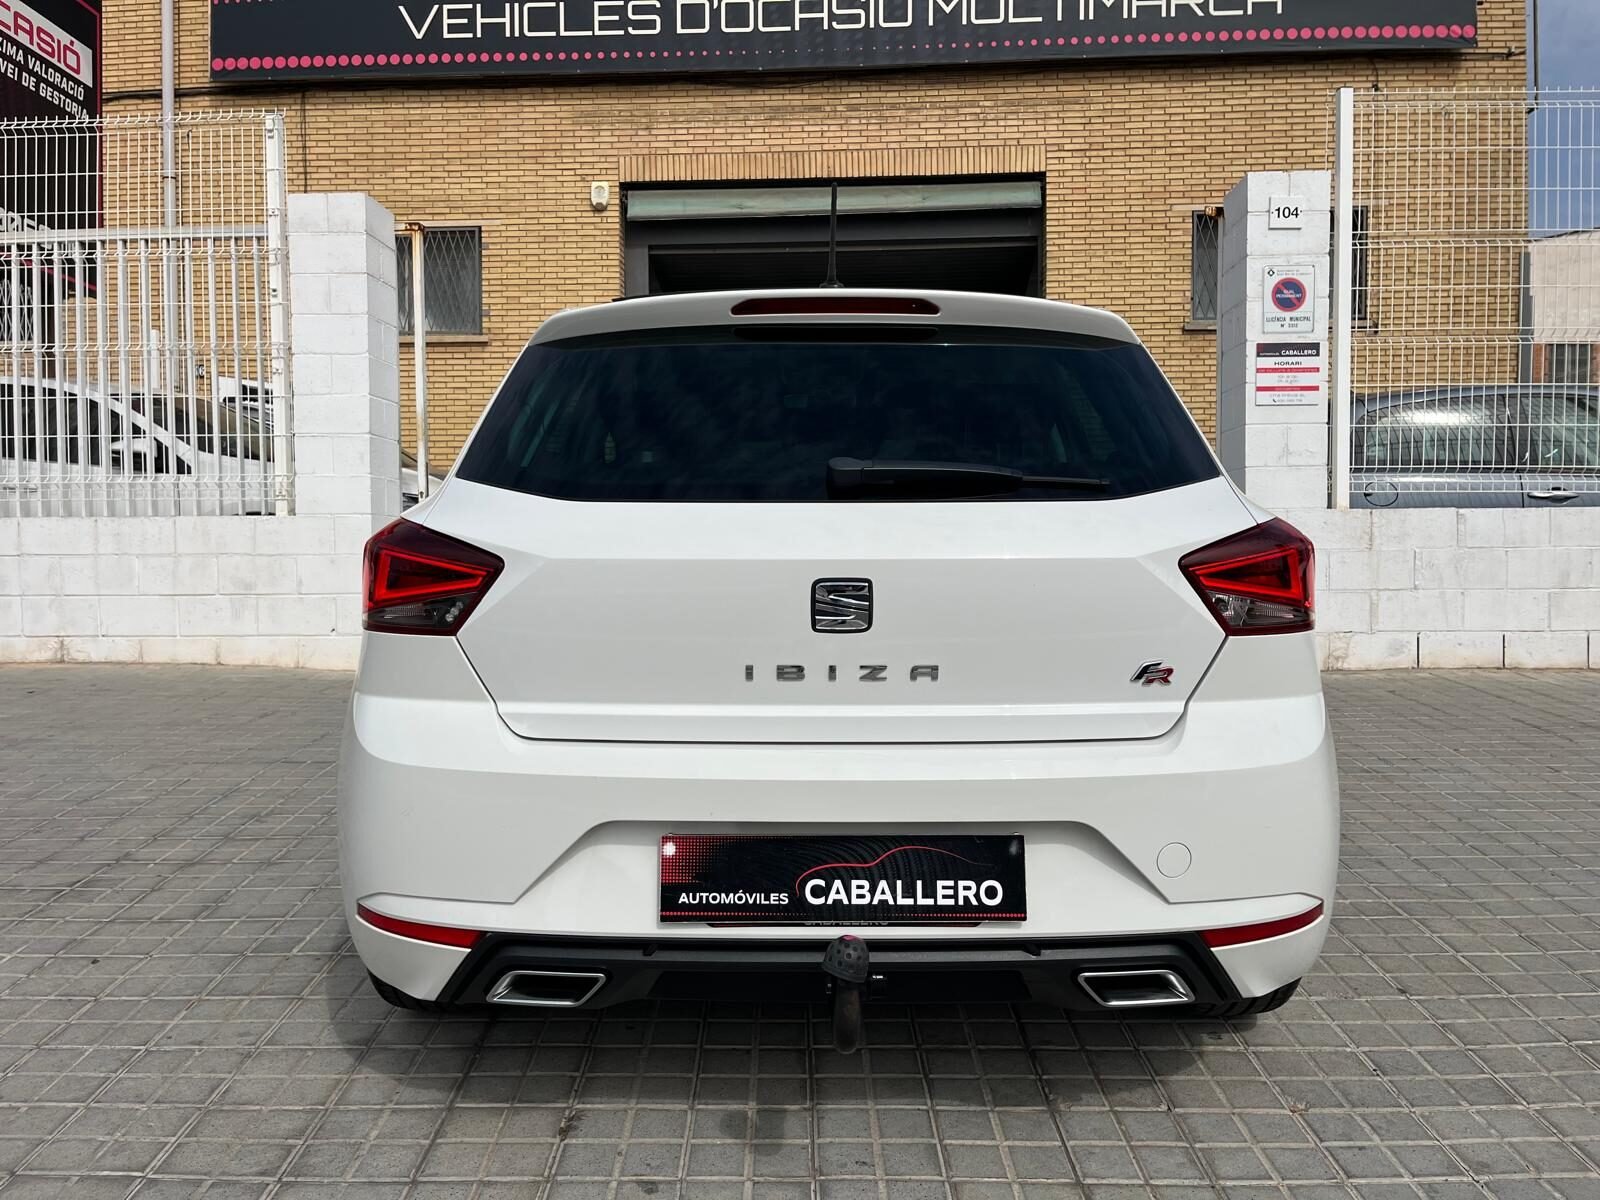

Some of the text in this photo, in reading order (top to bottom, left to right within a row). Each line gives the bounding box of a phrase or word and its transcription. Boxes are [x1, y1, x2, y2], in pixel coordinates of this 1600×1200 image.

[398, 0, 661, 39] VEHICLES
[28, 55, 85, 101] VALORACIÓ
[22, 71, 36, 91] DE
[39, 82, 88, 120] GESTORIA
[1275, 206, 1299, 219] 104
[745, 664, 939, 682] IBIZA
[1129, 659, 1174, 687] FR
[678, 878, 1004, 907] AUTOMÓVILES CABALLERO
